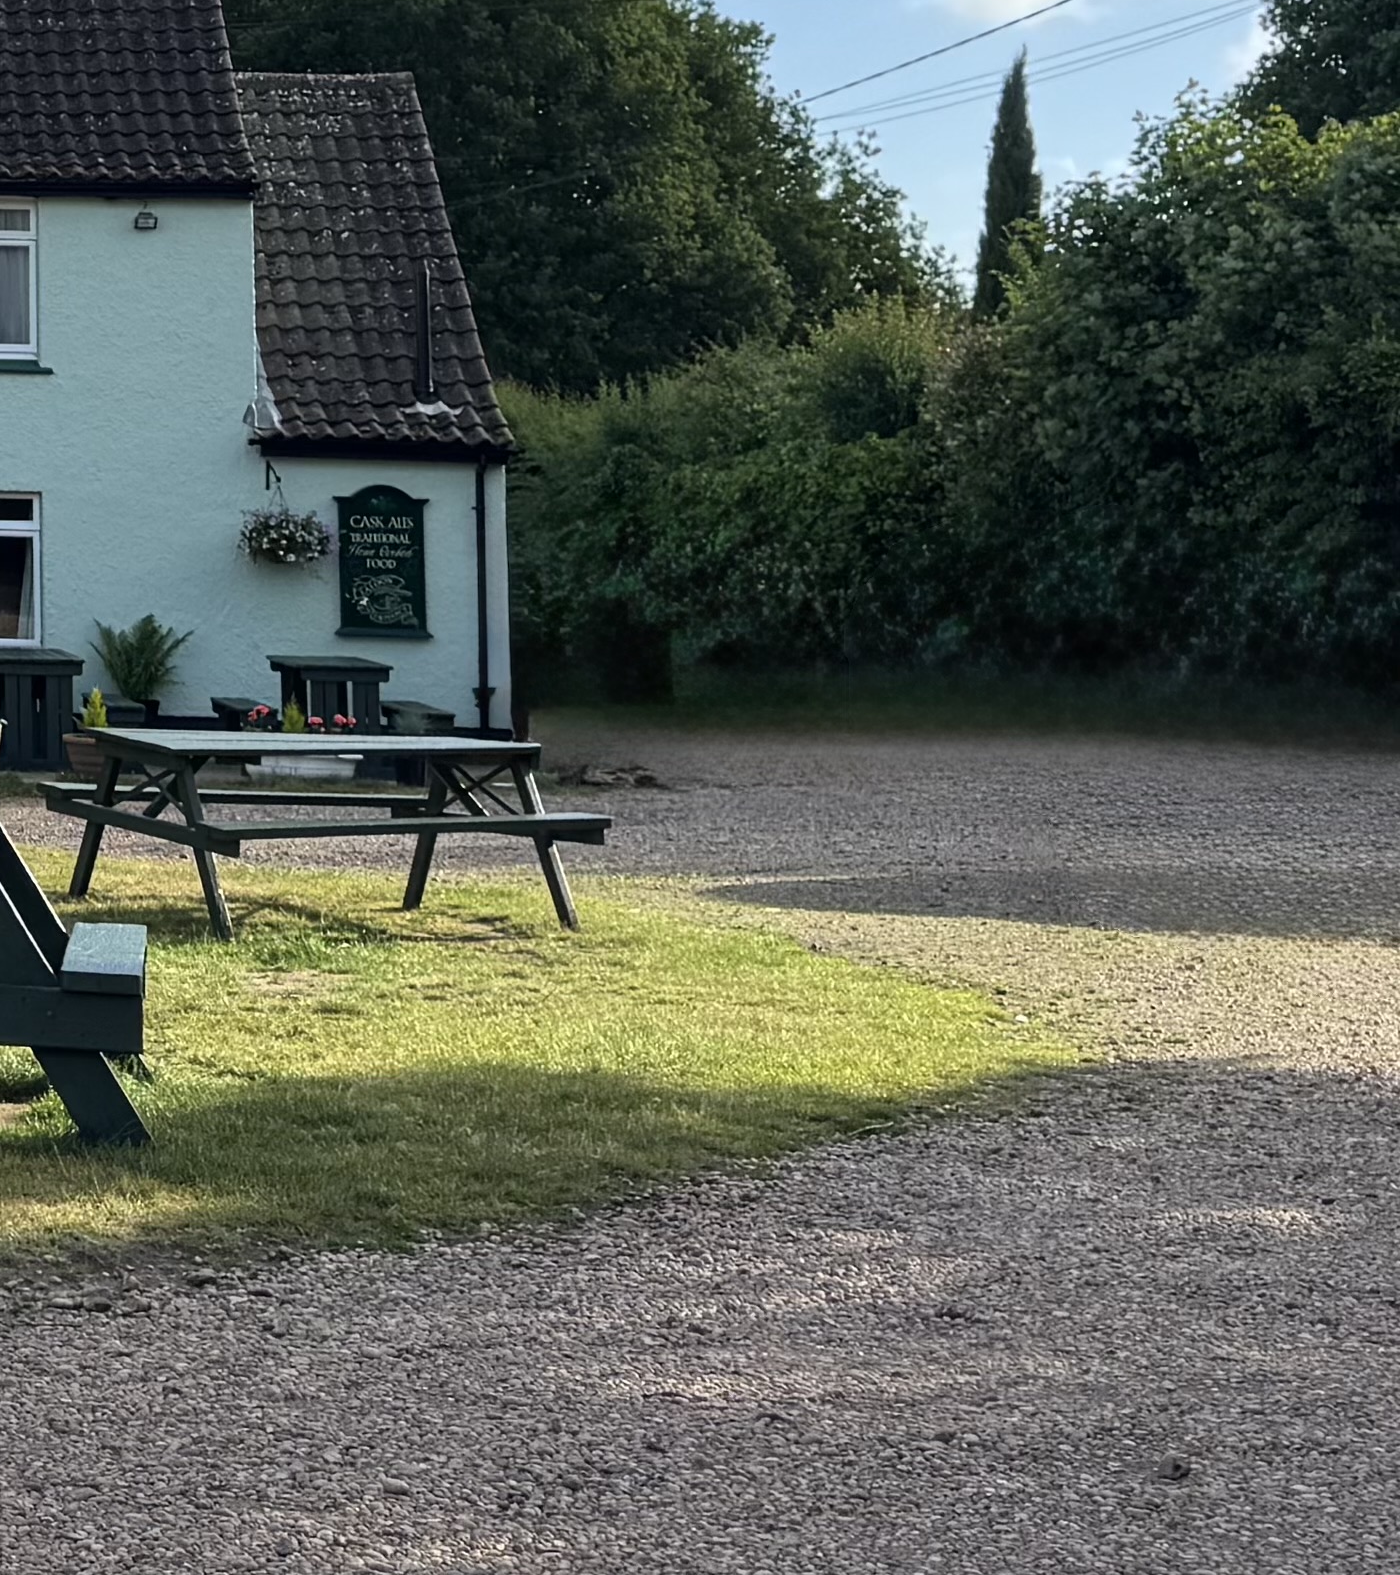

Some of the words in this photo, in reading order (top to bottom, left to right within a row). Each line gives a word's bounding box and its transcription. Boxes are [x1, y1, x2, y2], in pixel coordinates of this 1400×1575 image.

[350, 515, 384, 529] CASK
[387, 516, 414, 529] ALES
[349, 532, 411, 544] TRADITIONAL
[366, 558, 397, 569] FOOD
